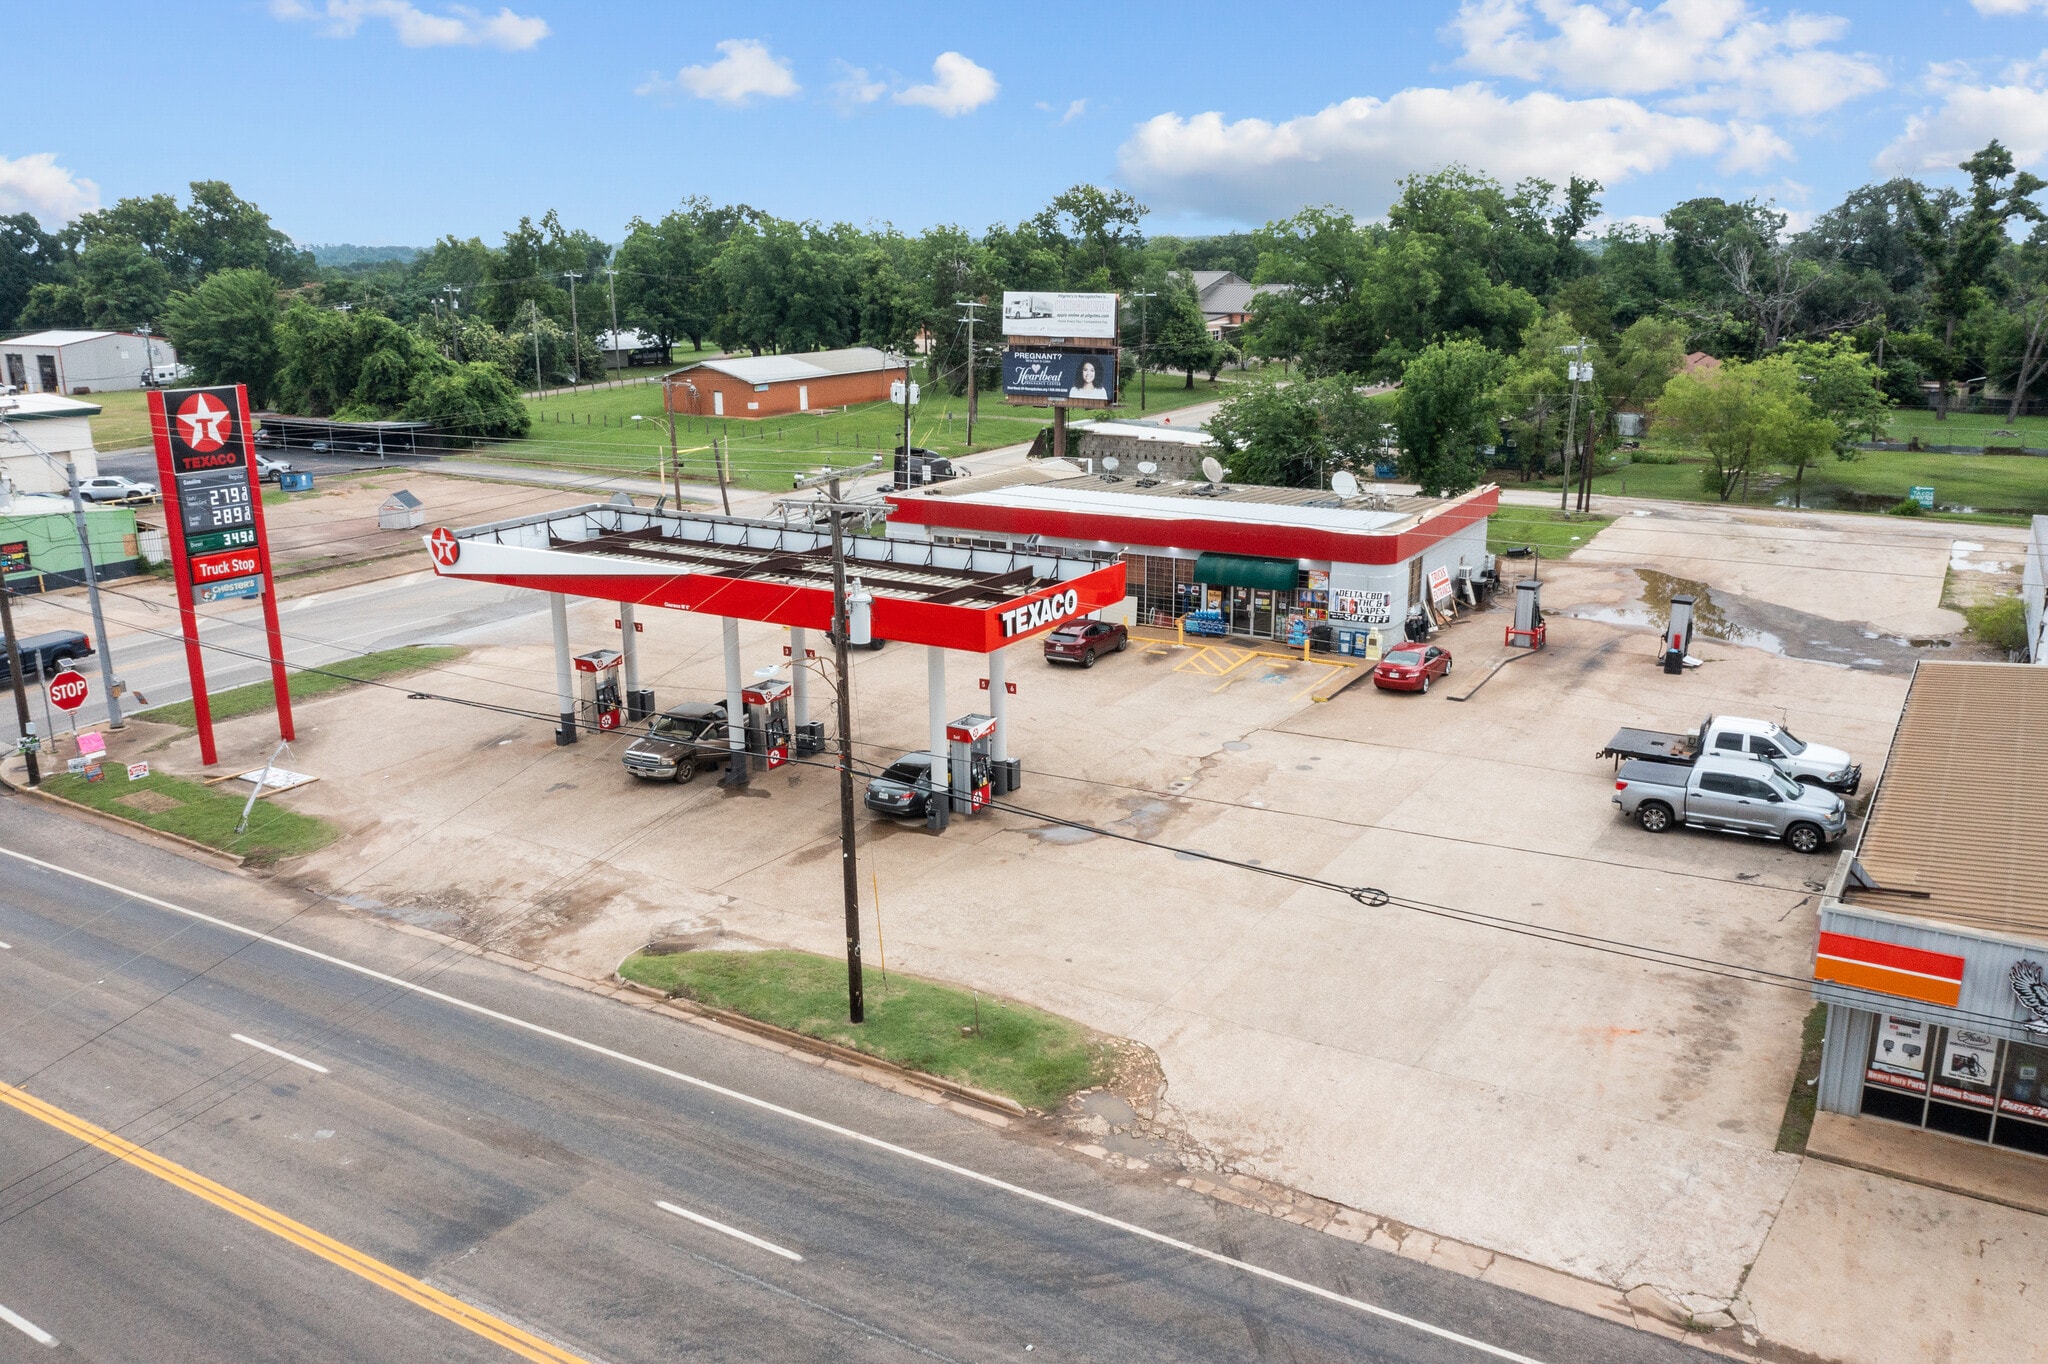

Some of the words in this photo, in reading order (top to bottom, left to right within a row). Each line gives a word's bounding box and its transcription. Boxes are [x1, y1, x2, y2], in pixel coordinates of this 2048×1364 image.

[1014, 352, 1063, 361] PREGNANT?
[1012, 366, 1063, 385] Heartbeat
[183, 453, 236, 469] TEXACO
[209, 487, 240, 506] 279
[212, 507, 243, 526] 289
[223, 530, 248, 546] 349
[199, 561, 230, 577] Truck
[231, 558, 255, 573] Stop
[1339, 589, 1363, 599] DELTA
[1365, 592, 1383, 600] CBD
[1358, 598, 1374, 607] THC
[1001, 588, 1078, 638] TEXACO
[1359, 606, 1387, 615] VAPES
[1367, 614, 1390, 624] OFF
[51, 680, 86, 702] STOP
[1867, 1070, 1891, 1083] Heavy
[1890, 1074, 1907, 1087] Duty
[1907, 1078, 1927, 1091] Parts
[1932, 1084, 1962, 1099] Welding
[1961, 1091, 1994, 1106] Supplies
